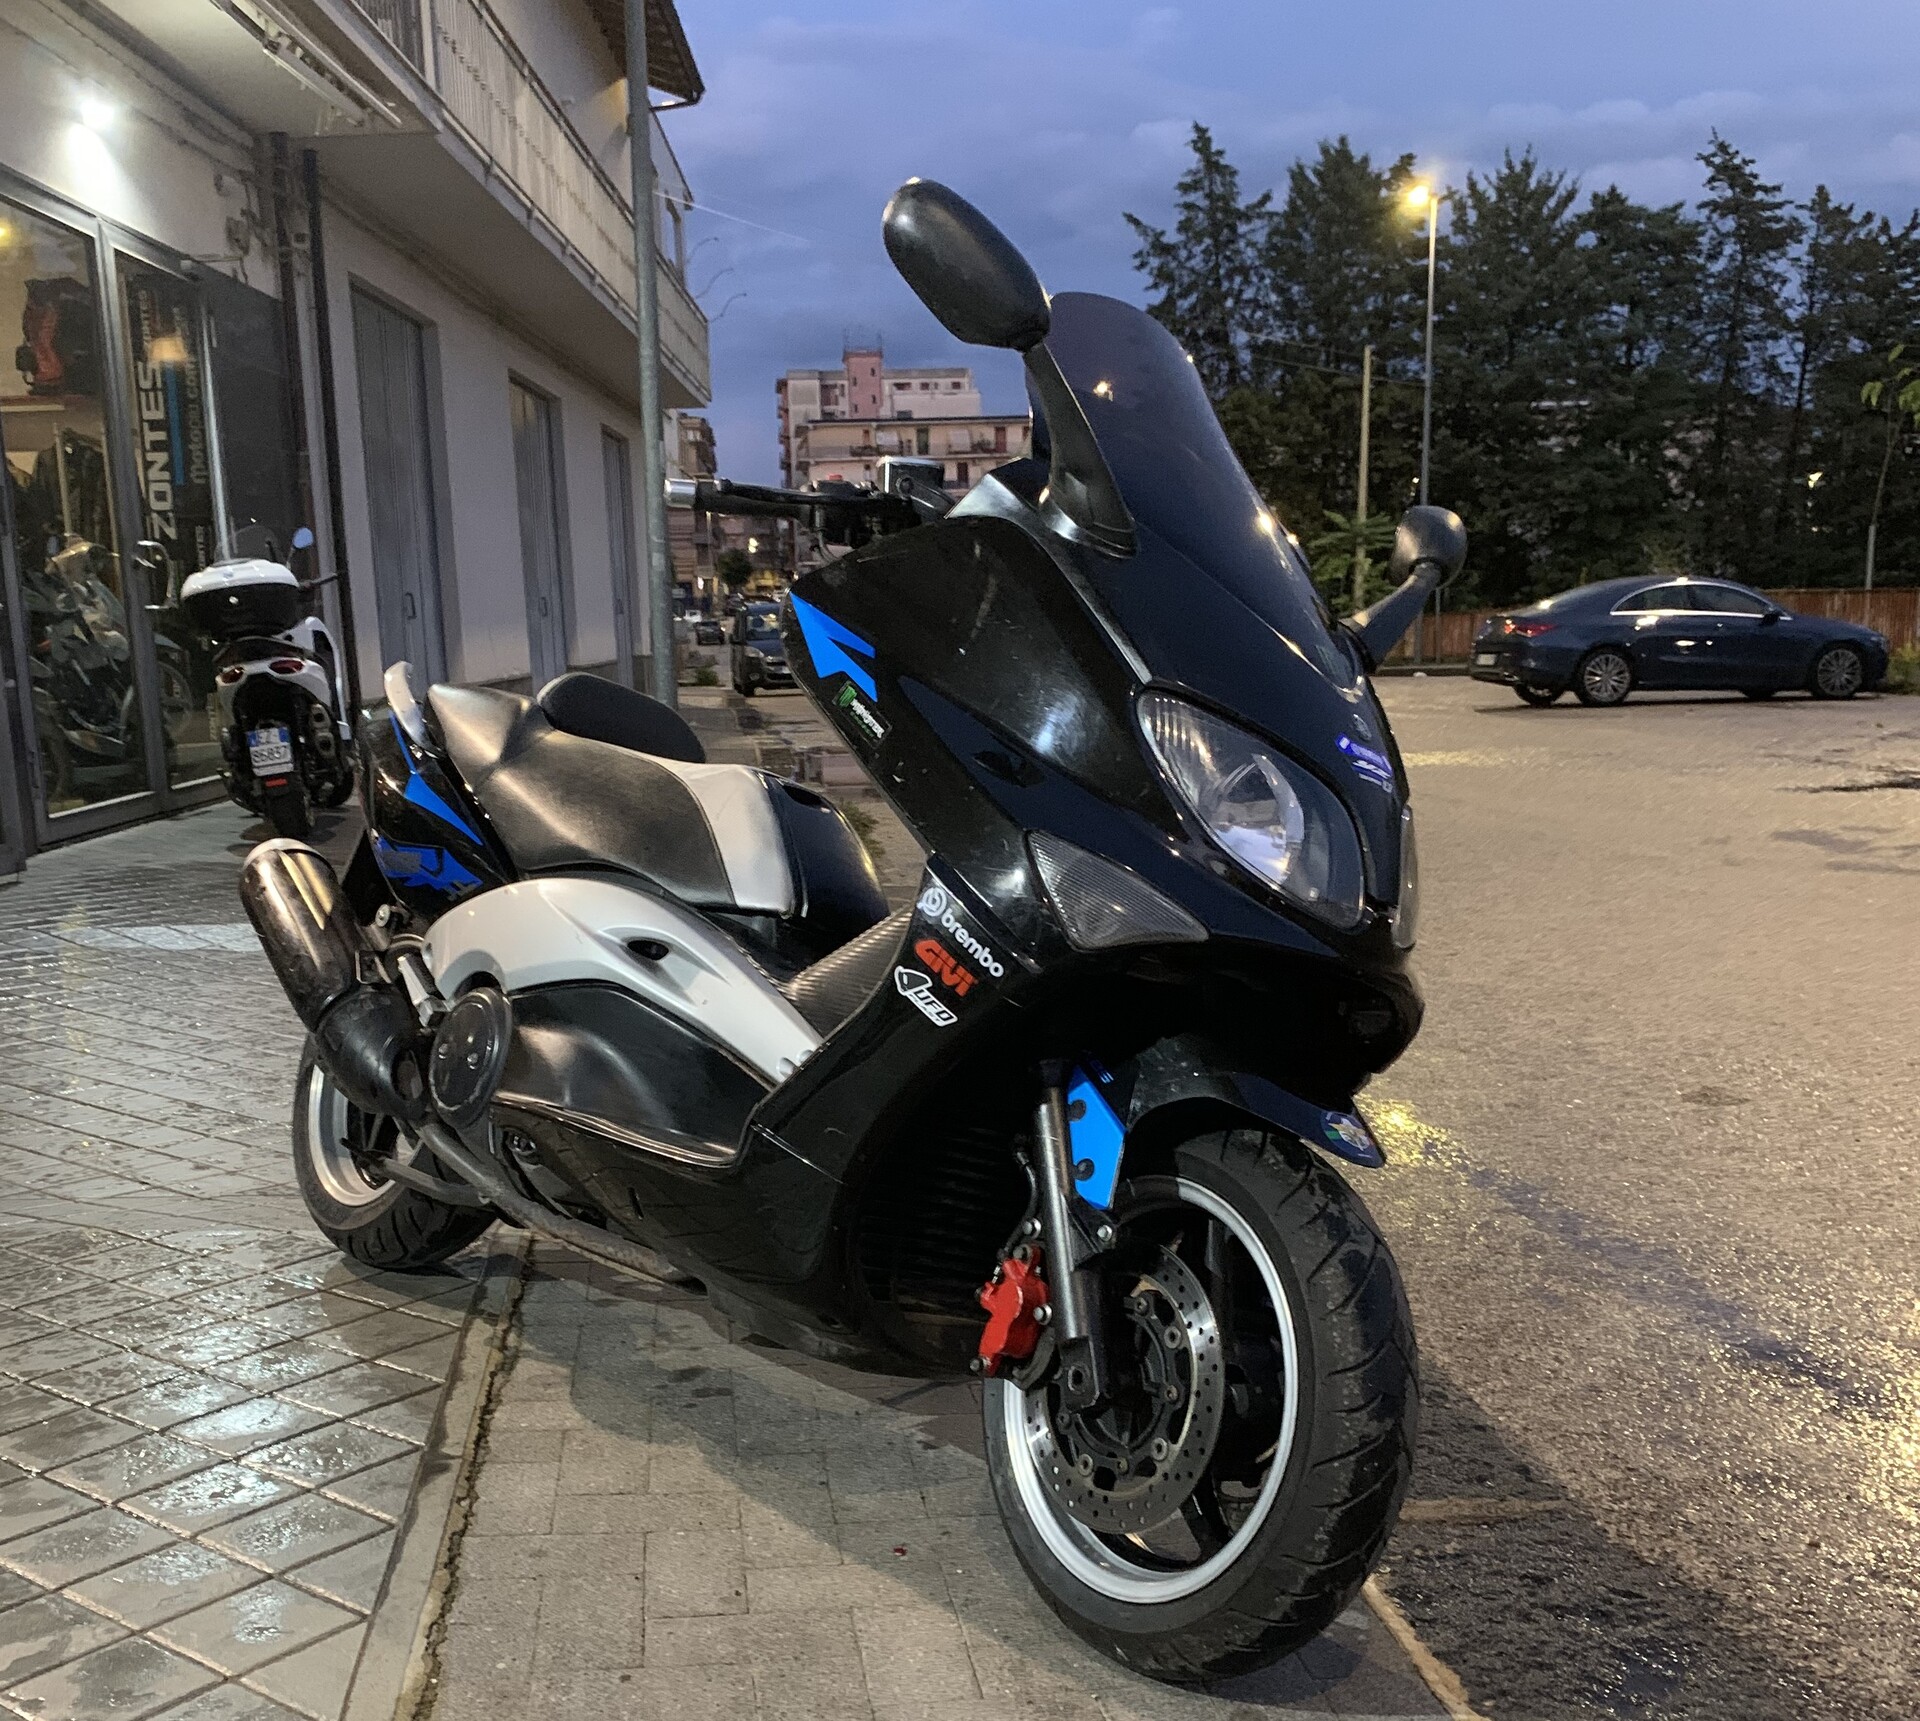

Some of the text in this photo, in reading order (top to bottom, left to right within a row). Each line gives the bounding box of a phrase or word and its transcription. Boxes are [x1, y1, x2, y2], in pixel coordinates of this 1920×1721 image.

[138, 361, 178, 540] ZONTES
[914, 939, 974, 997] GIVI
[941, 908, 1004, 977] brembo
[913, 989, 954, 1021] UFO
